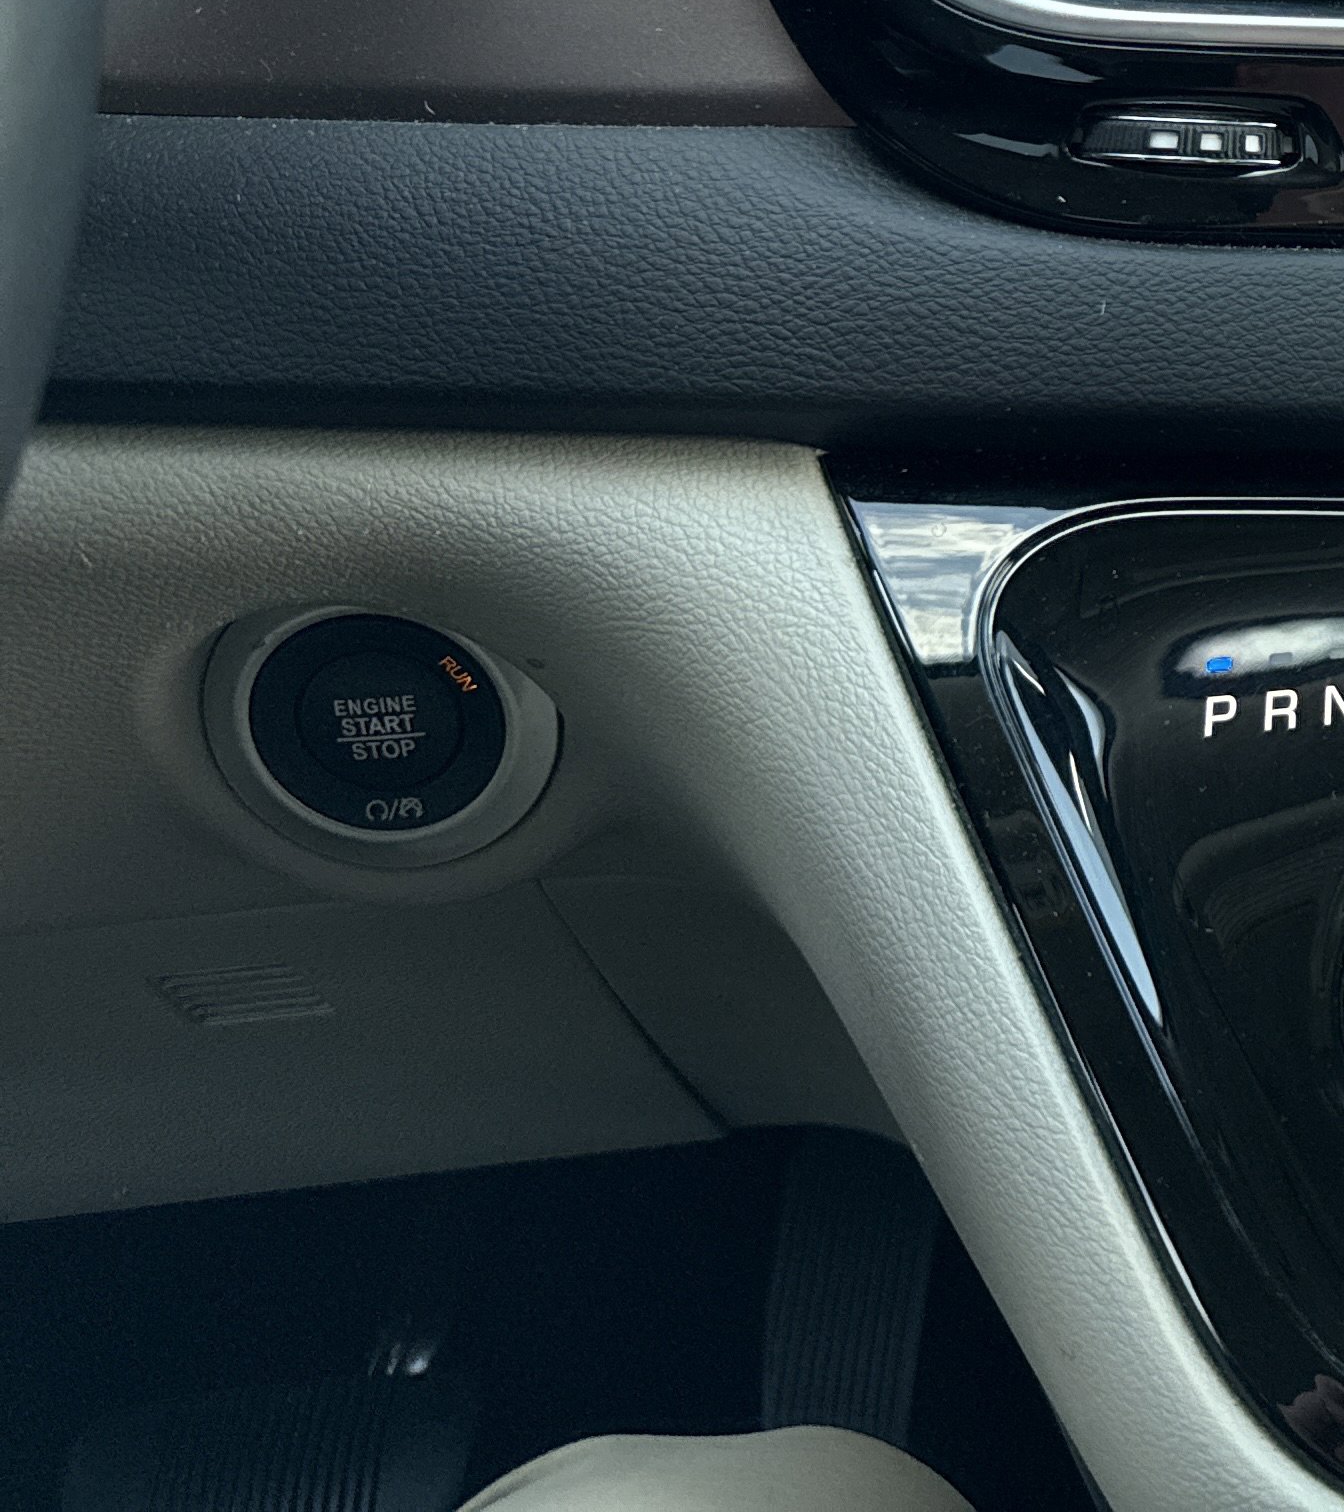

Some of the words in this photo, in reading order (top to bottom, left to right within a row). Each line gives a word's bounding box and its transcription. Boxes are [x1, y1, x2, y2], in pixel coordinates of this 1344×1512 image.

[438, 656, 478, 692] RUN
[334, 695, 416, 716] ENGINE
[341, 714, 414, 736] START
[352, 740, 415, 760] STOP
